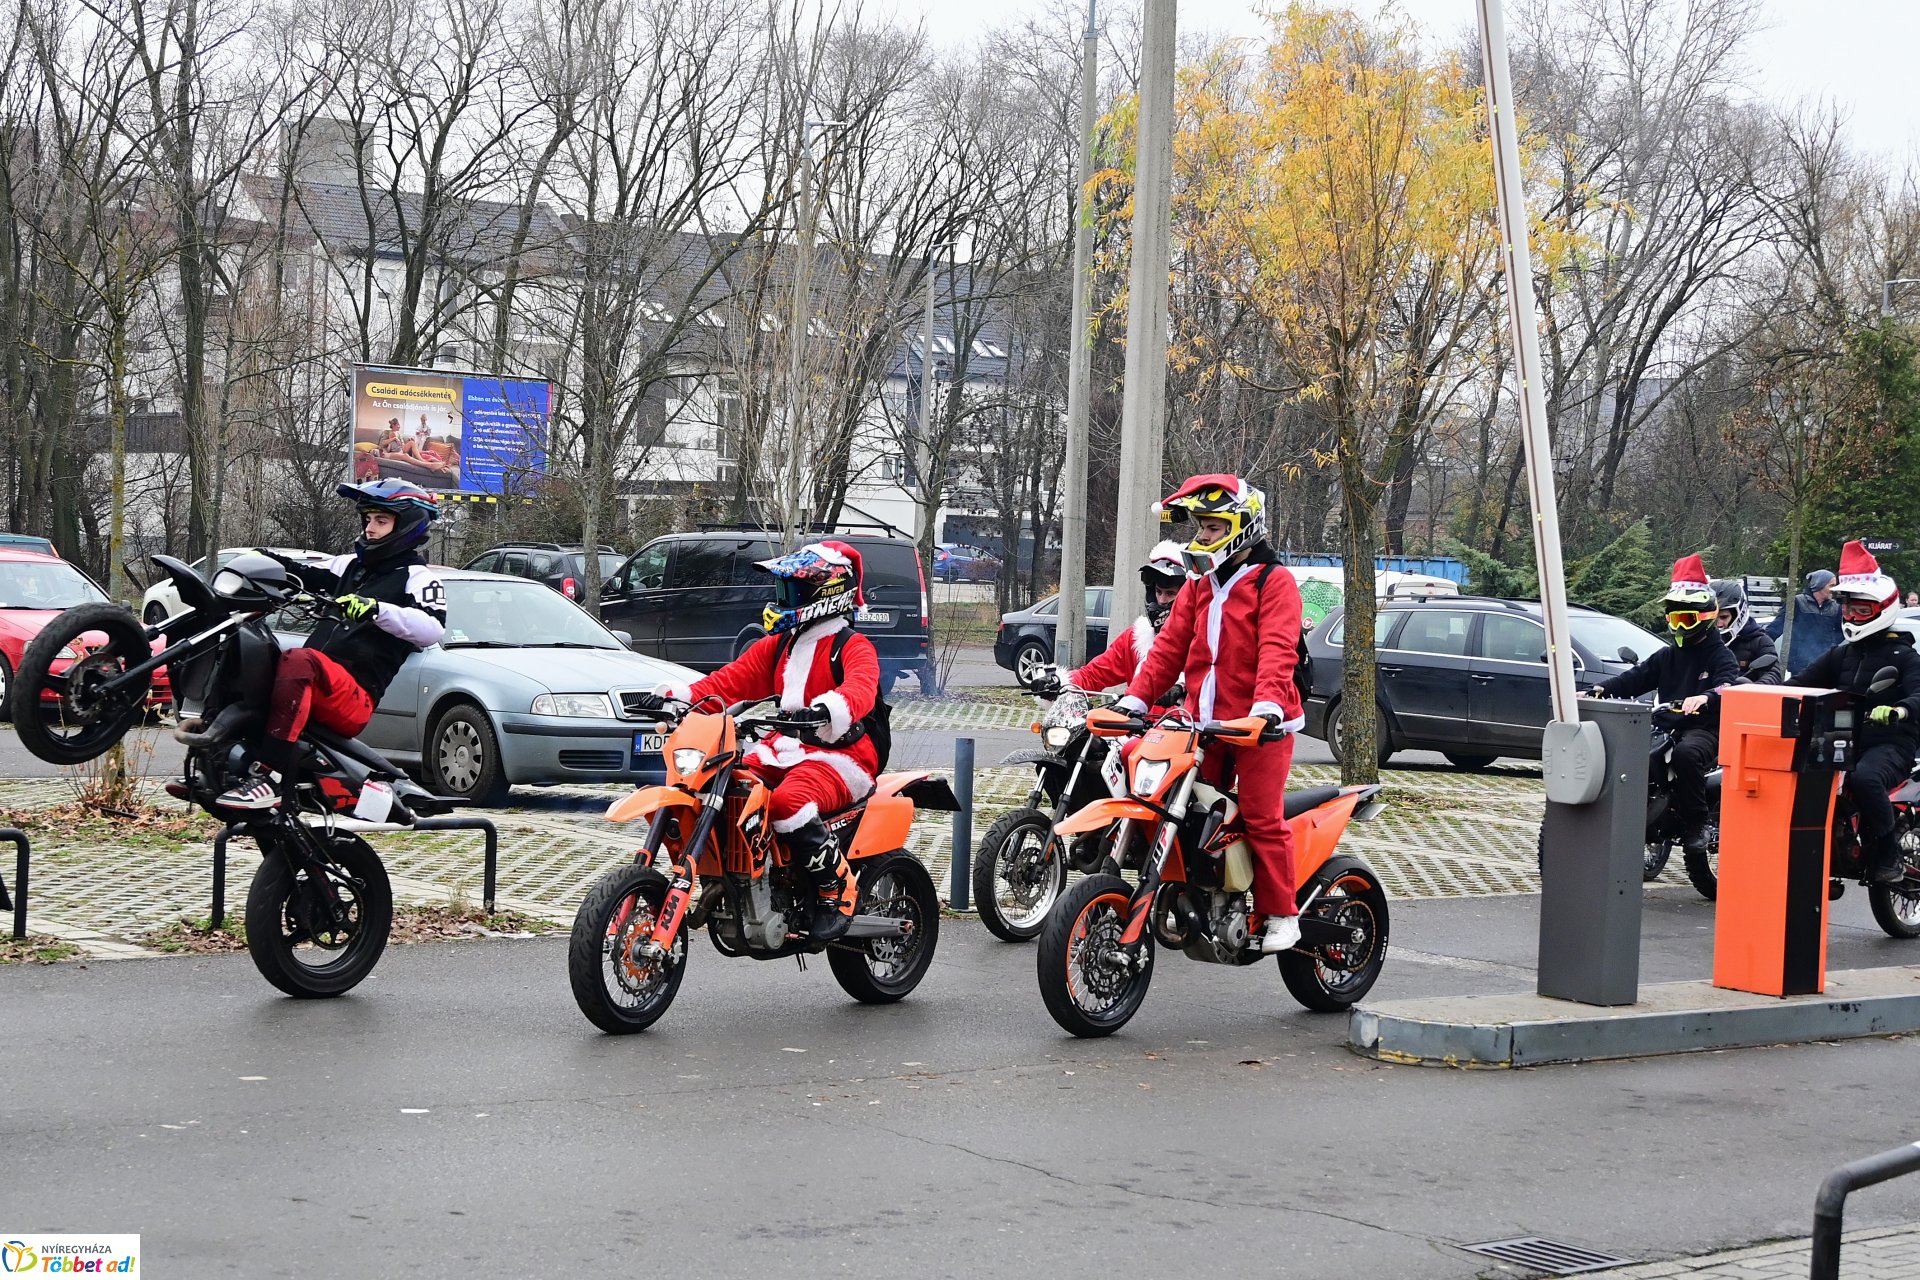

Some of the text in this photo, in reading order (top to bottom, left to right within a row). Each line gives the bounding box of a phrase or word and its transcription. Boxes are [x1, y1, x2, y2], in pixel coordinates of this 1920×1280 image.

[371, 386, 452, 400] Családi adócsökkentés
[372, 400, 381, 408] Az
[382, 399, 392, 408] Ön
[393, 402, 430, 412] családjának
[1868, 541, 1893, 550] KIJÁRAT
[821, 584, 845, 597] RAVEN
[660, 894, 680, 931] KTM
